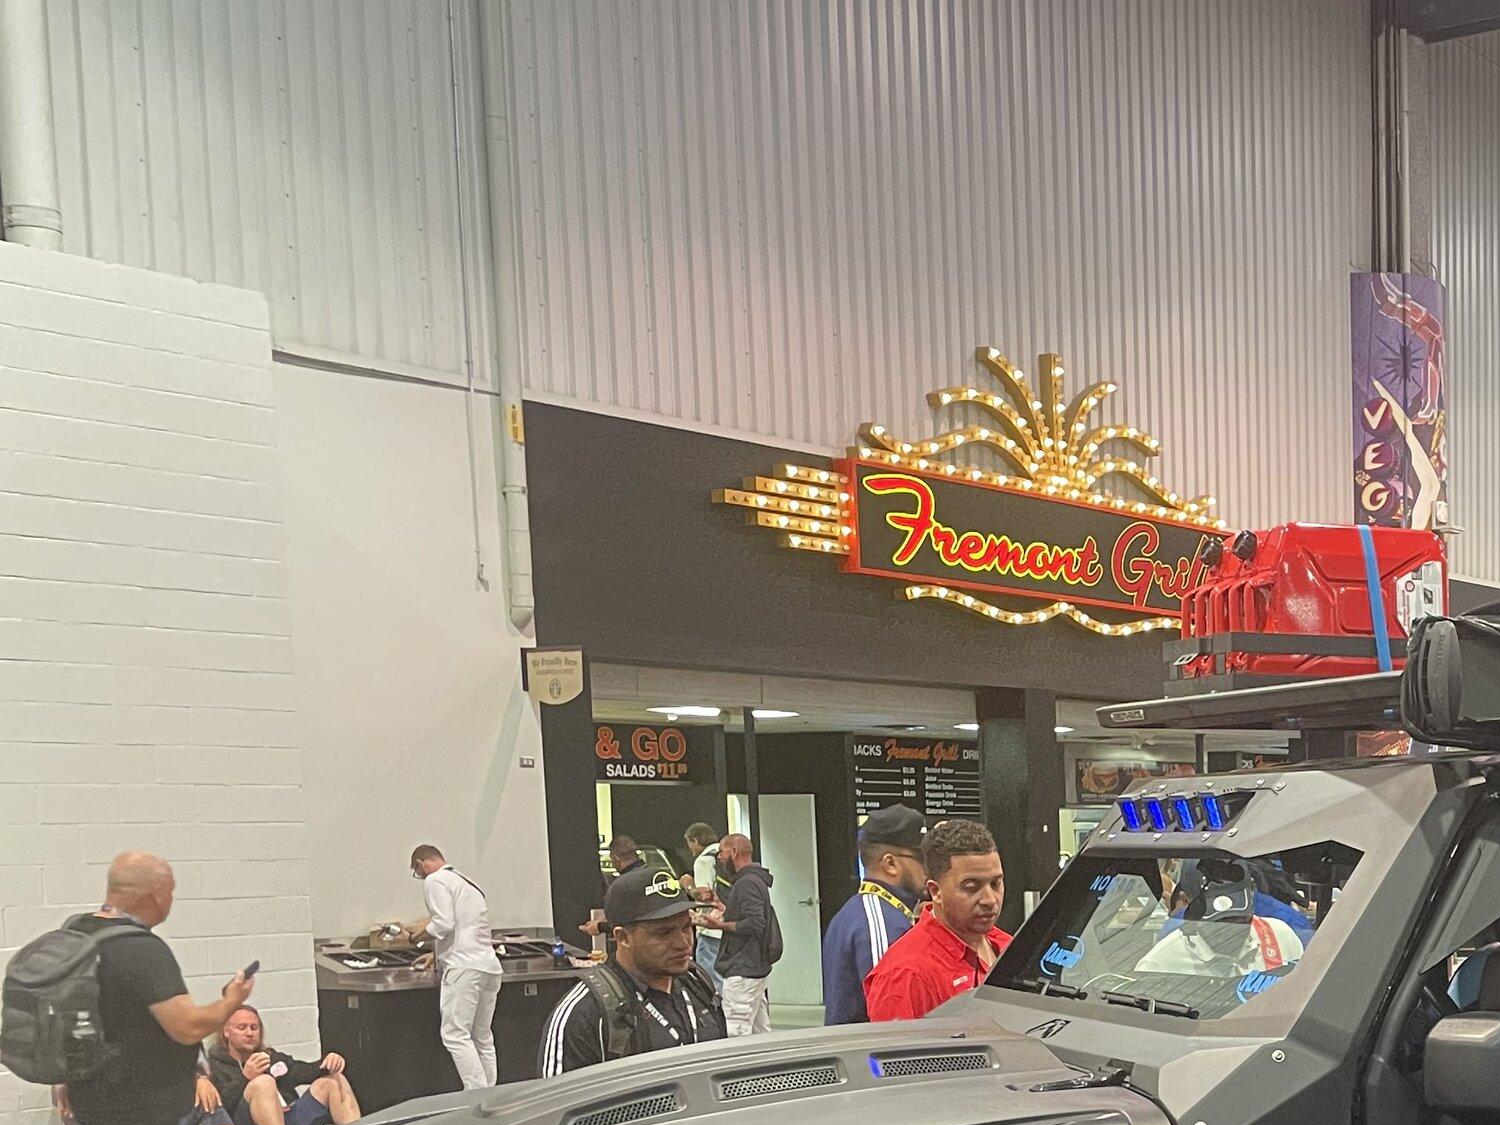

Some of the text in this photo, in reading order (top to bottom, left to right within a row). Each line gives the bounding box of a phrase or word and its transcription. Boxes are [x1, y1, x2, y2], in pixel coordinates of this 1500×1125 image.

[862, 473, 1206, 608] Fremont Gril
[596, 726, 687, 762] & GO
[606, 763, 656, 778] SALADS
